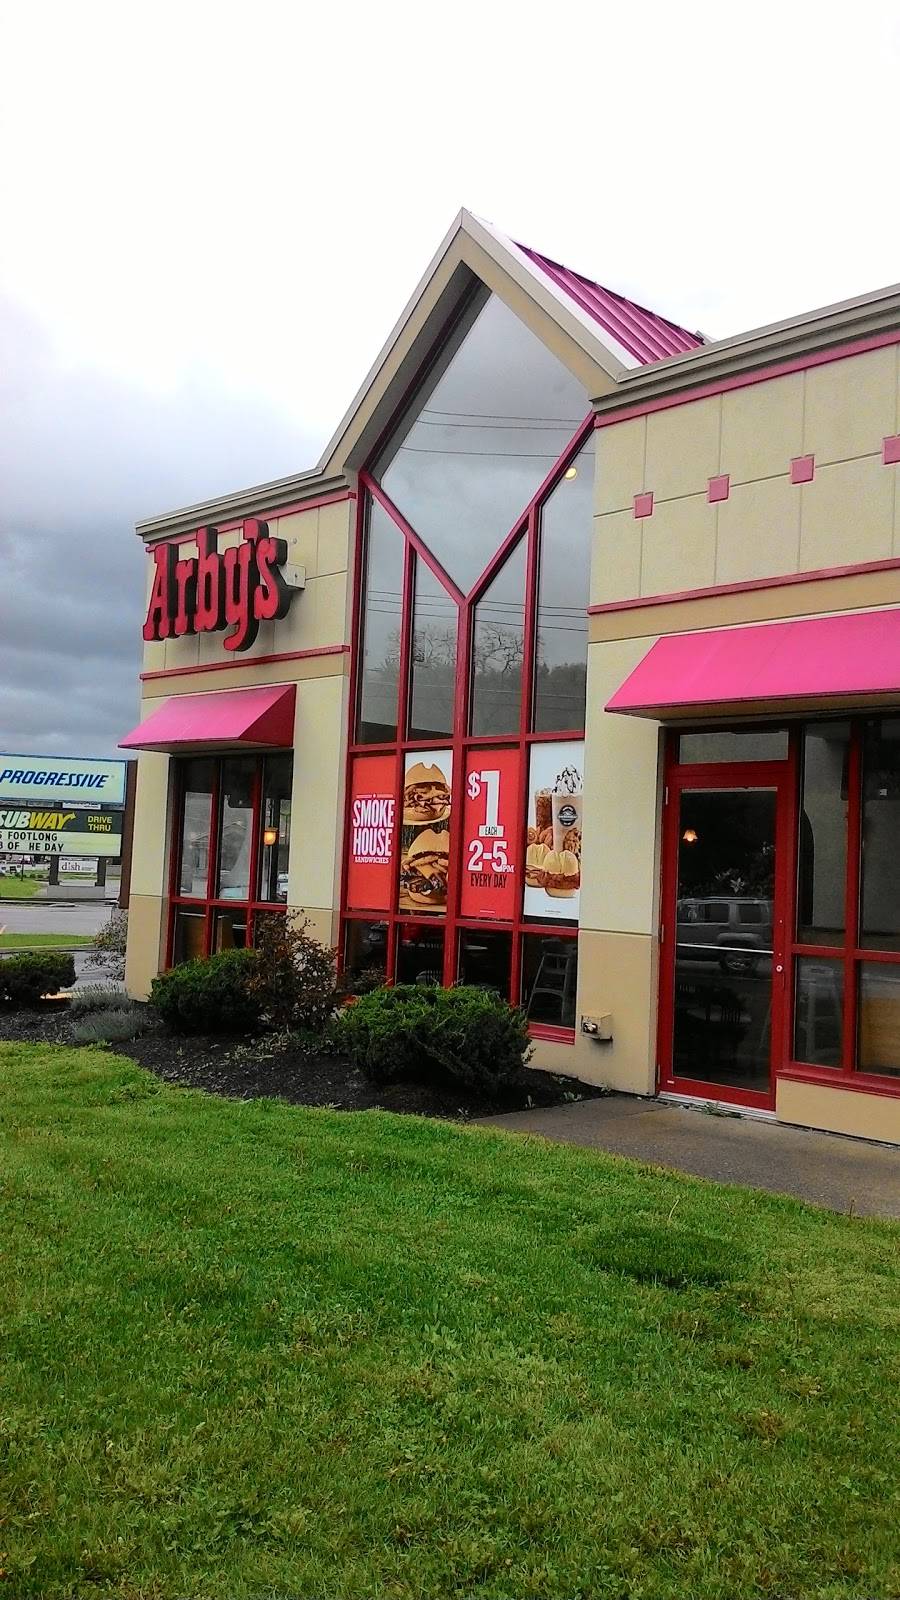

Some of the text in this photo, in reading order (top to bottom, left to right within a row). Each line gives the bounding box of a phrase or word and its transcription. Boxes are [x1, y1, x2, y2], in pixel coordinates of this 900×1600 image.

[143, 518, 288, 651] Arby's
[0, 769, 109, 788] PROGRESSIVE
[468, 771, 504, 837] $1
[353, 799, 395, 827] SMOKE
[88, 823, 111, 832] THRU
[485, 826, 498, 835] EACH
[8, 831, 57, 841] FOOTLONG
[353, 828, 392, 856] HOUSE
[8, 841, 20, 850] OF
[45, 843, 64, 852] DAY
[61, 862, 80, 871] dish
[355, 856, 389, 864] SANDWICHES
[471, 873, 507, 888] EVERY DAY
